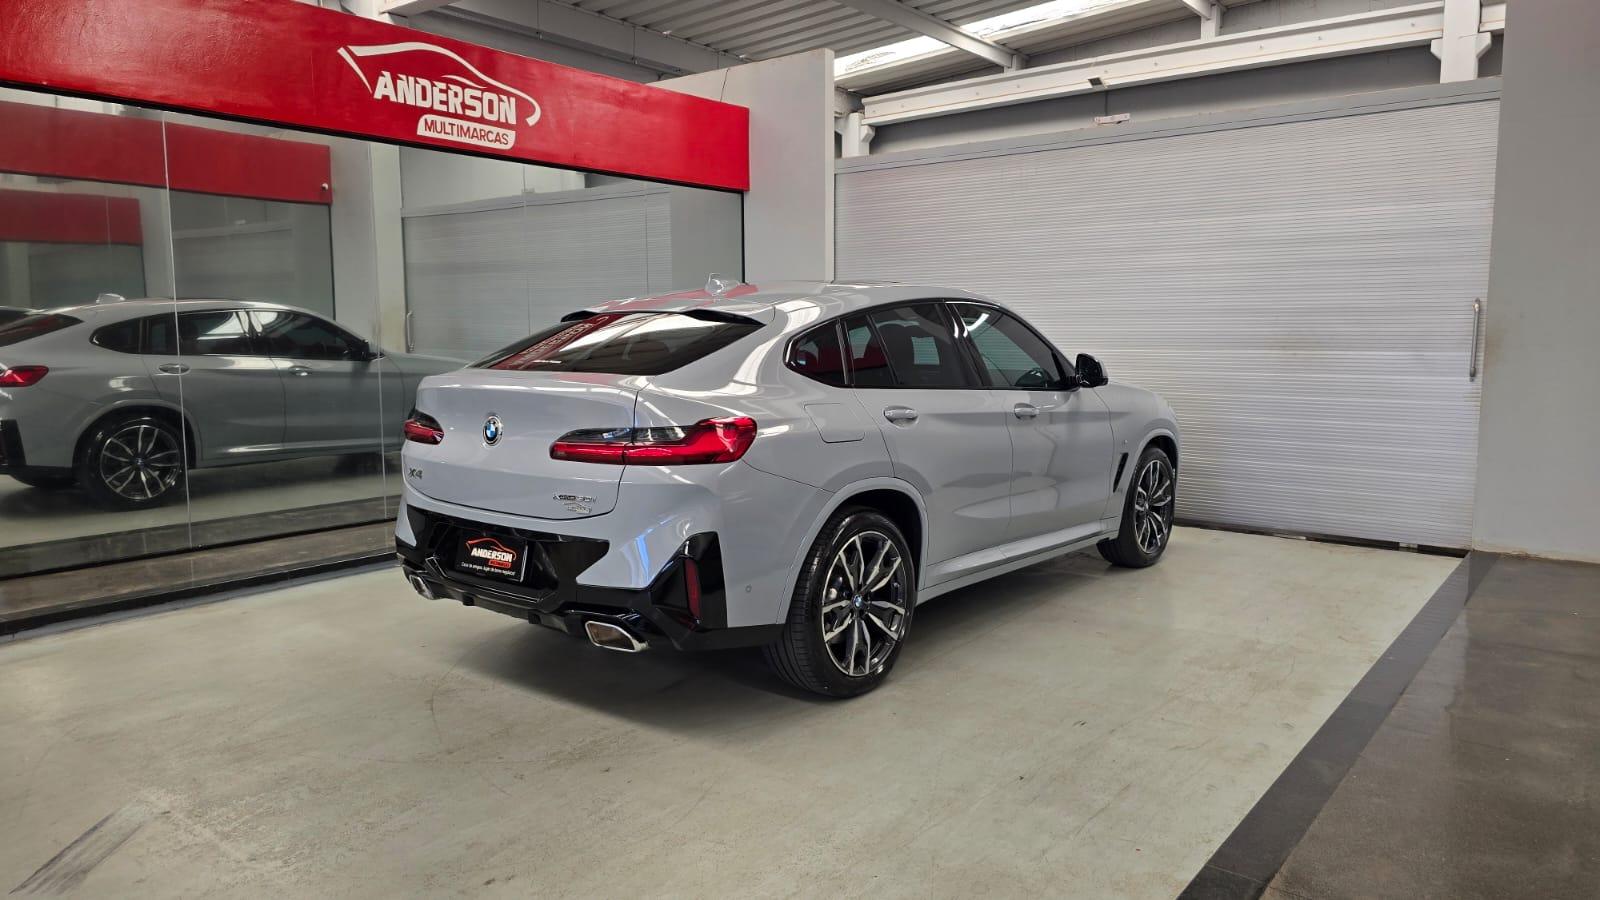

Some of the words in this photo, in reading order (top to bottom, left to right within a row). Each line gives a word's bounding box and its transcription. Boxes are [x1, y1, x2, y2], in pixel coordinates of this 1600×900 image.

[373, 70, 516, 125] ANDERSON
[424, 118, 509, 145] MULTIMARCAS
[471, 547, 513, 562] ANDERSON
